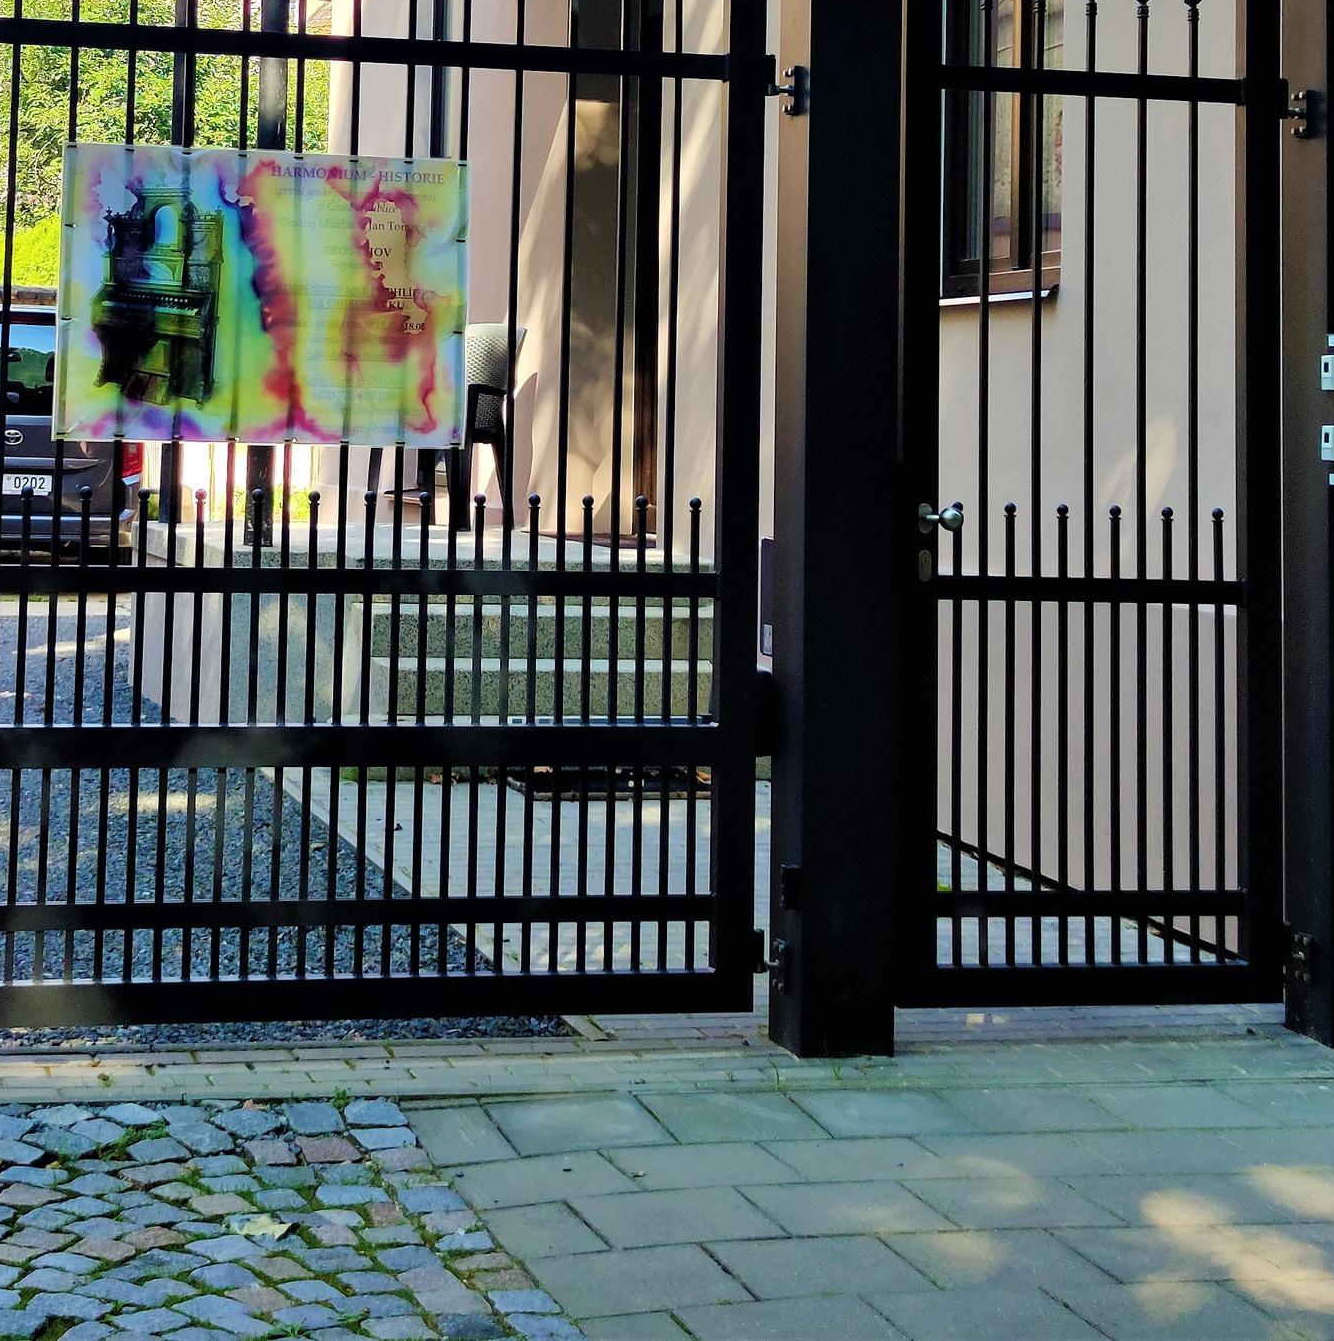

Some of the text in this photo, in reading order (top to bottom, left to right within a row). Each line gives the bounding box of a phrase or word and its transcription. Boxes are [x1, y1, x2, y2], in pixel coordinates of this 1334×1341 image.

[271, 166, 366, 180] HARMONIUM
[379, 171, 444, 184] HISTORIE
[367, 219, 385, 232] Jan
[323, 245, 392, 259] PROSJOV
